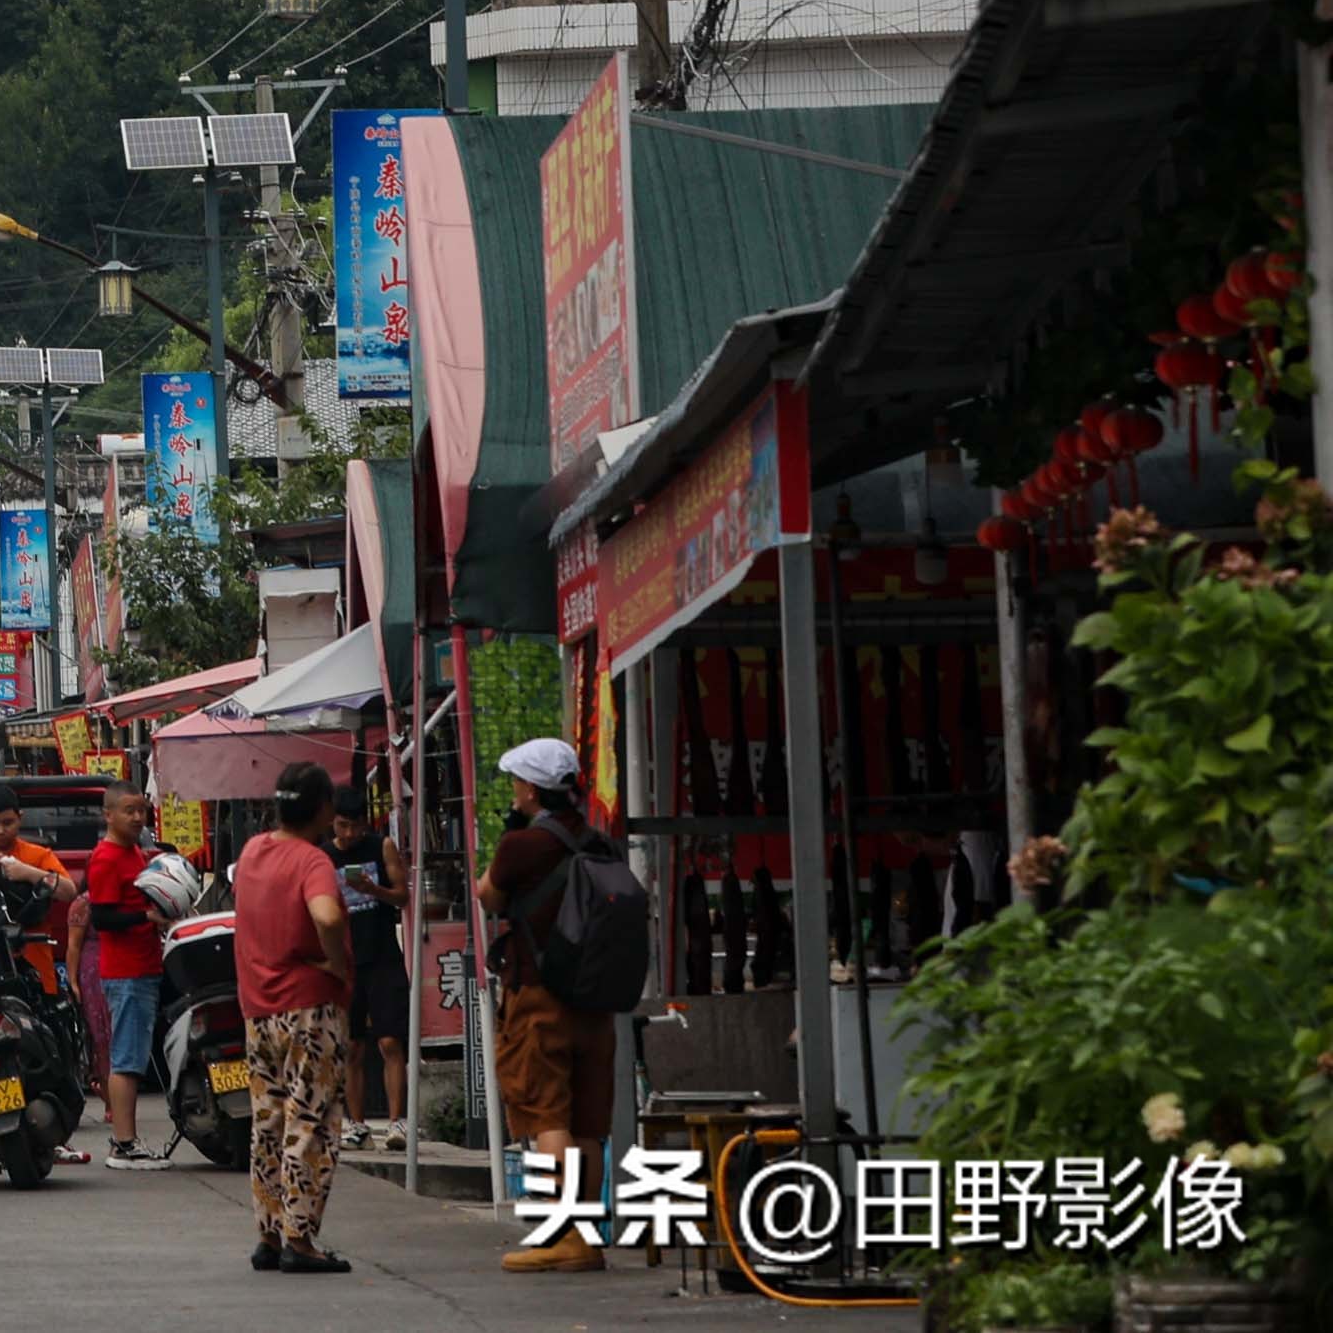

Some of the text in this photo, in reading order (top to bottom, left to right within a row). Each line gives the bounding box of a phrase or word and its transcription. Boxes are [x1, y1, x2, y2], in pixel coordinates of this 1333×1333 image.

[373, 154, 410, 345] 秦岭山泉
[167, 399, 194, 518] 秦岭山泉
